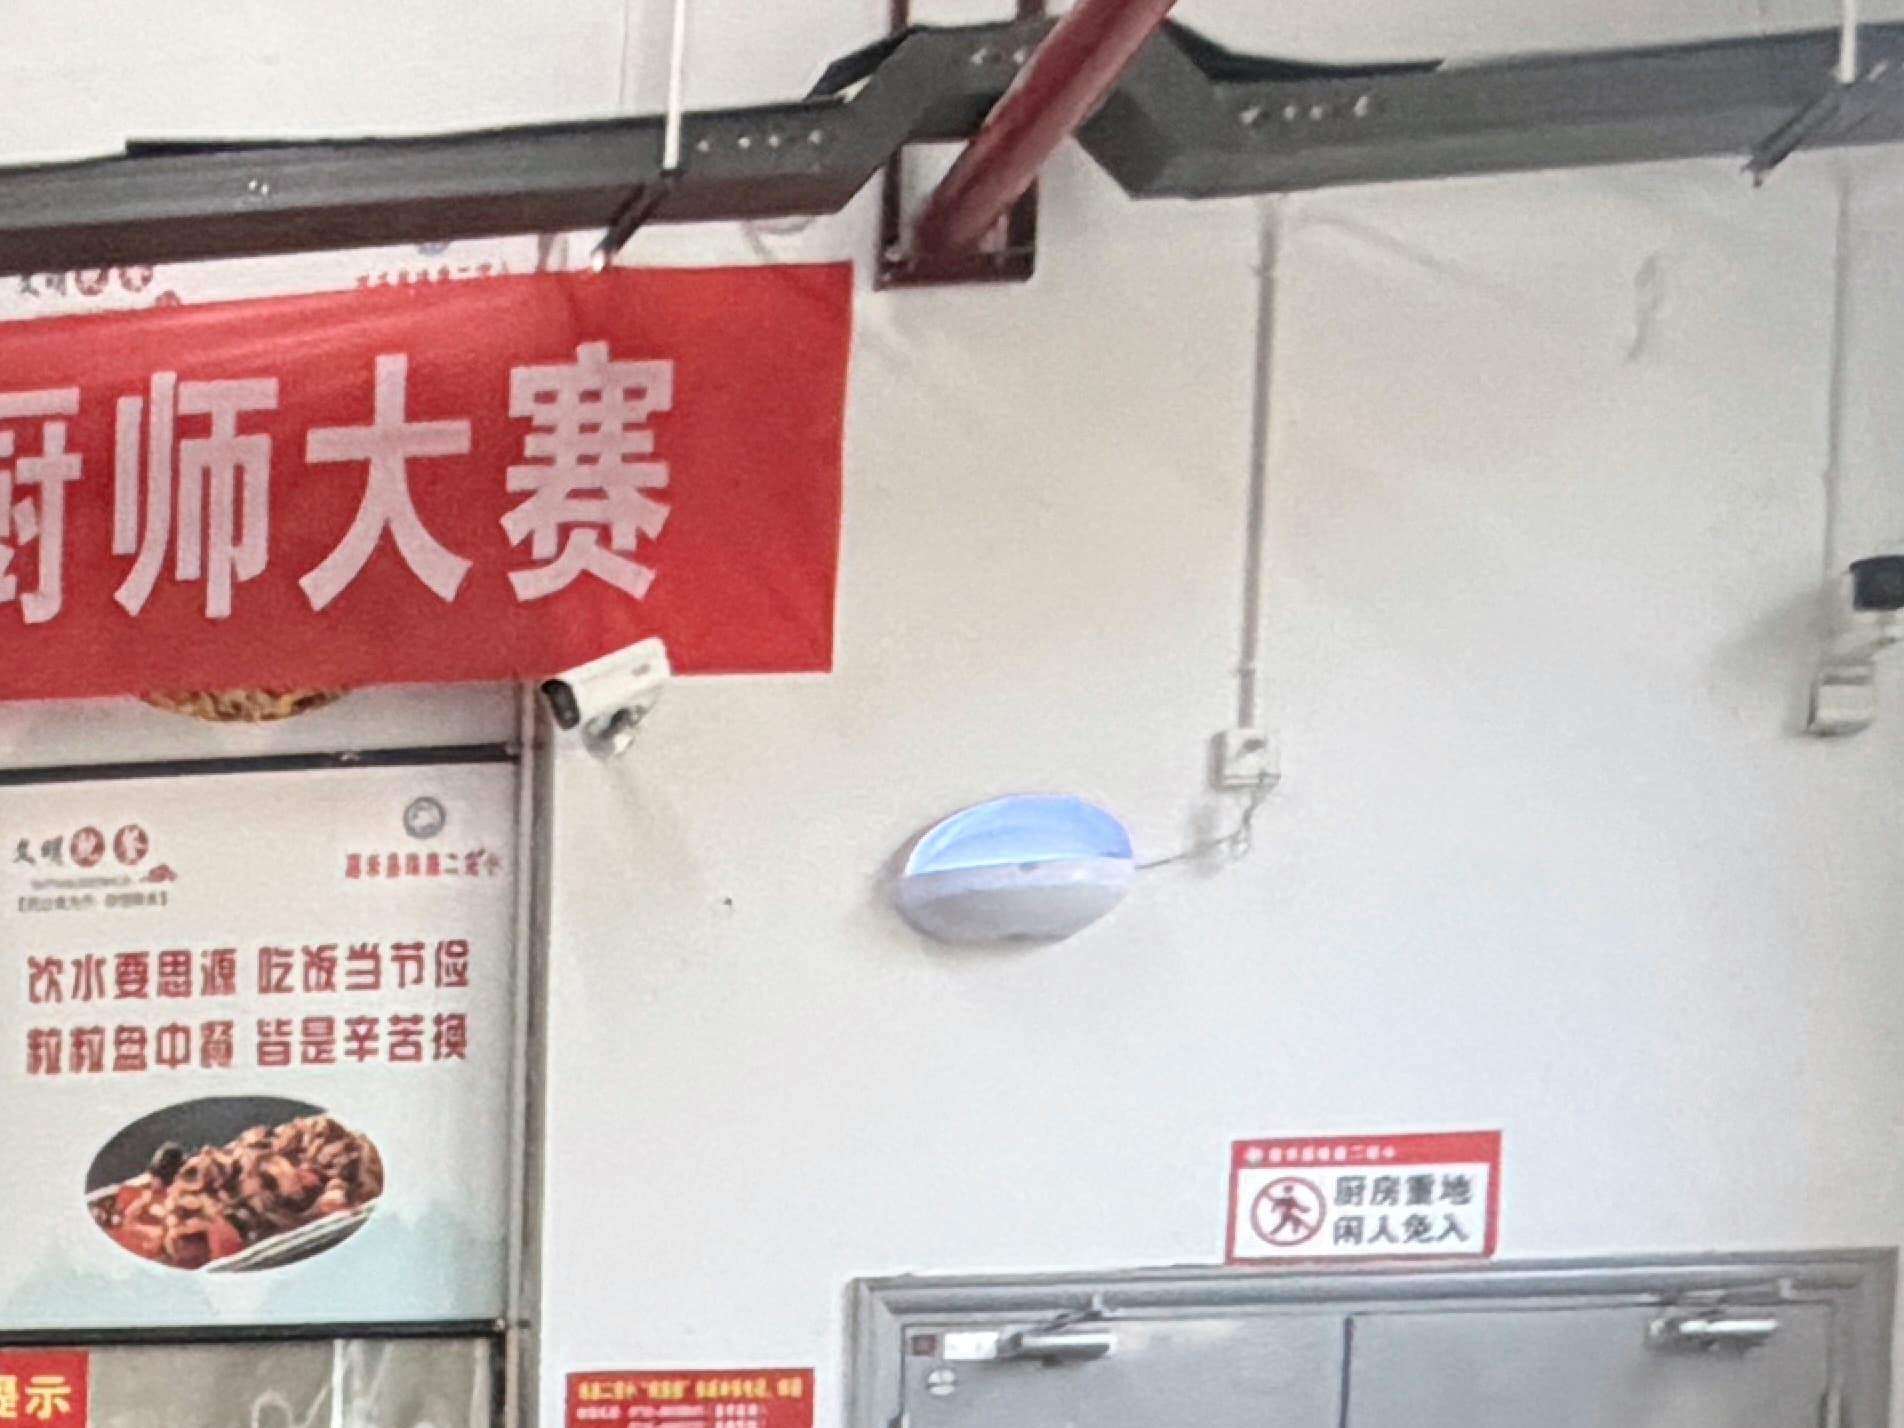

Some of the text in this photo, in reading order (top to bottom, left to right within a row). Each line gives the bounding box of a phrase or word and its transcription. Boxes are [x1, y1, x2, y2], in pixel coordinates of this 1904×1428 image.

[27, 938, 470, 1004] 饮水要思源 吃饭当节俭
[26, 1012, 469, 1075] 粒粒盘中餐 皆是辛苦换
[1334, 1173, 1474, 1207] 厨房重地
[1333, 1213, 1471, 1247] 闲人免入
